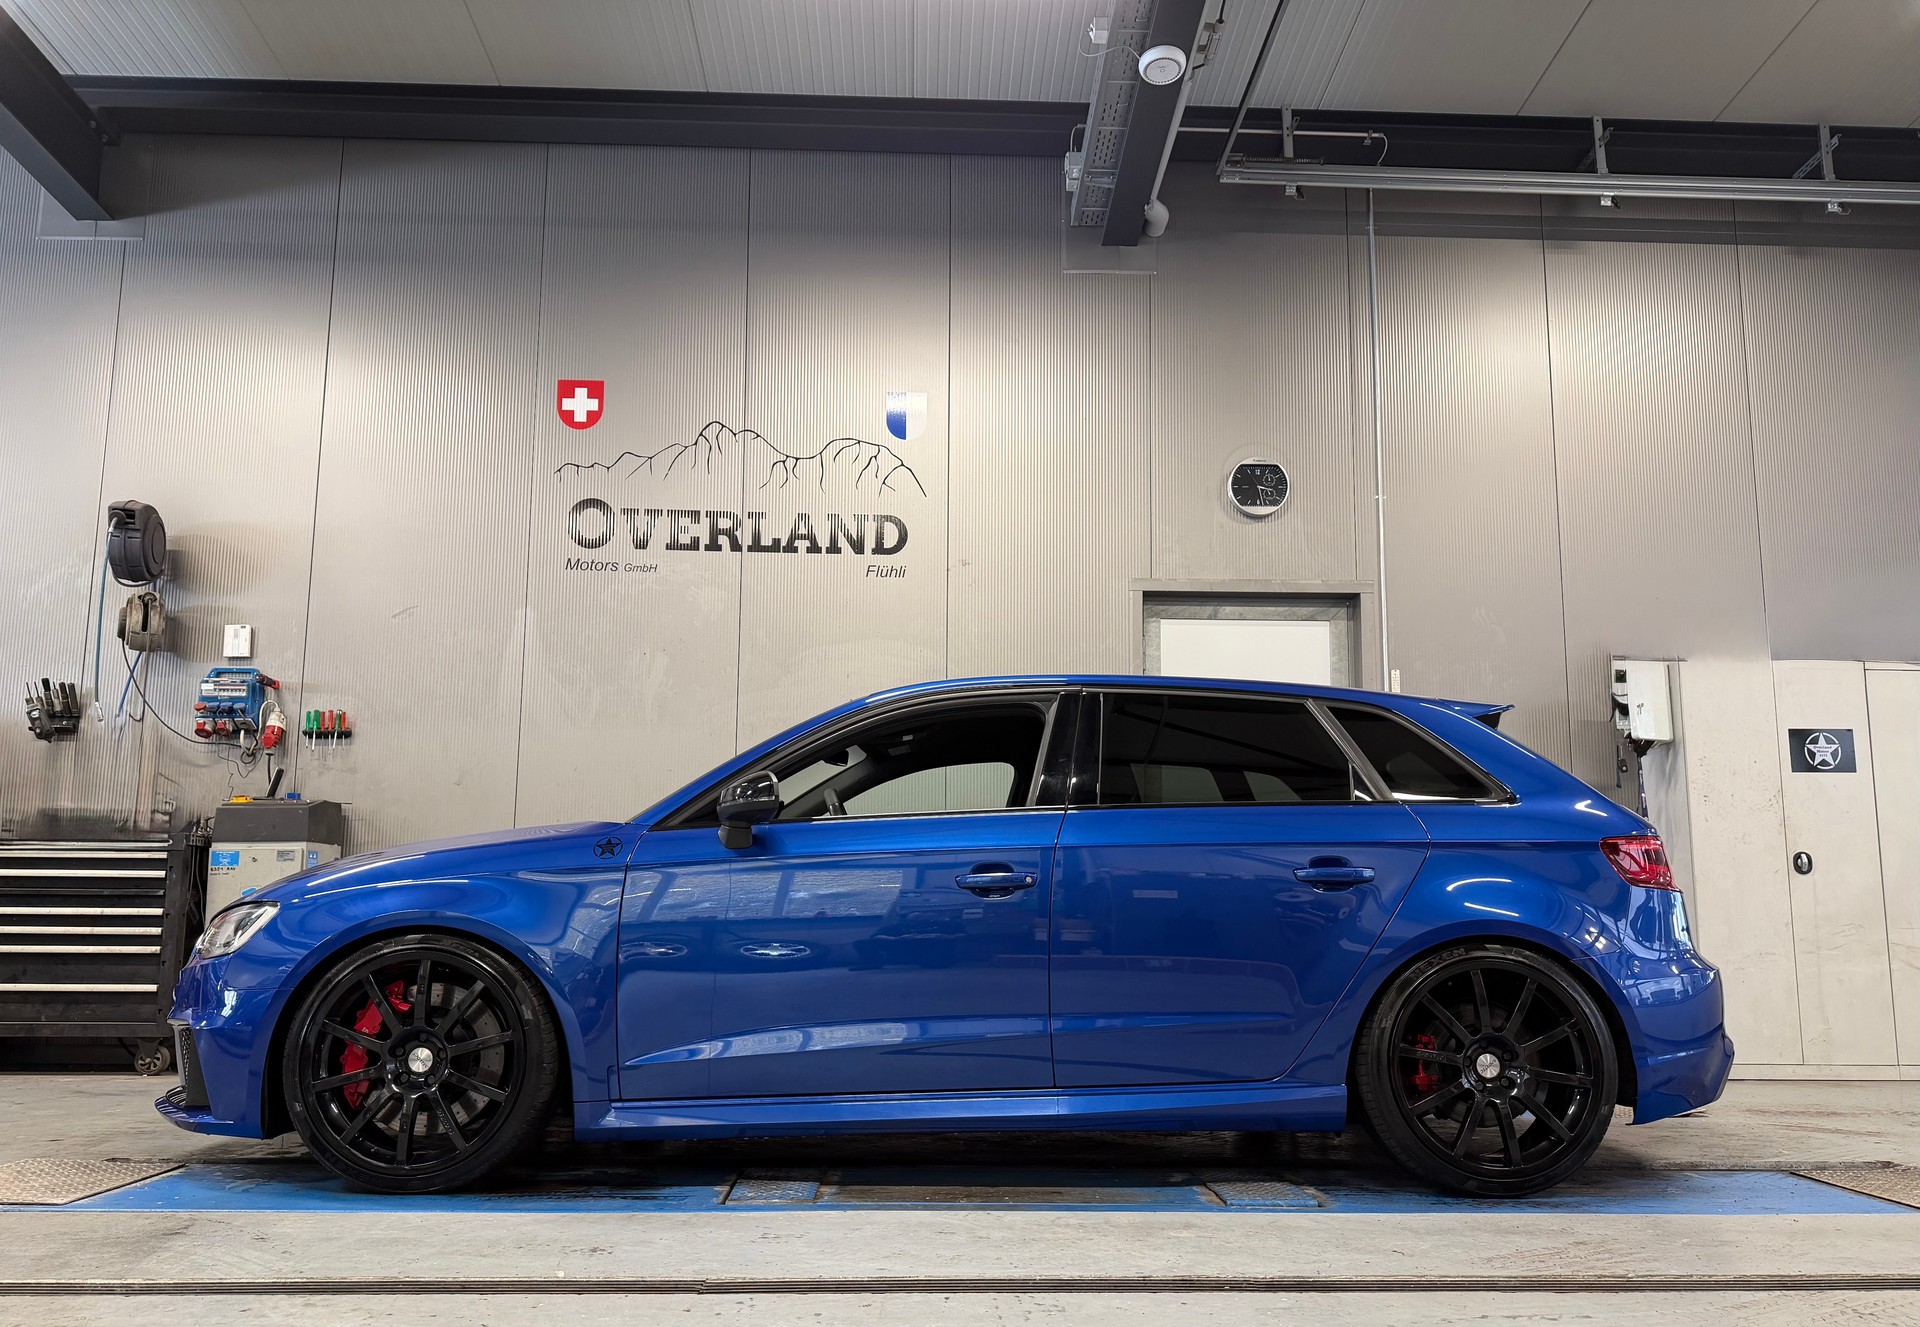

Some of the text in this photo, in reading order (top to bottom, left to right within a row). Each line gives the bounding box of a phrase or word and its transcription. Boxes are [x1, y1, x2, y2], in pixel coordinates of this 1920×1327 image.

[567, 497, 909, 556] OVERLAND
[565, 557, 658, 573] Motors GmbH
[866, 564, 907, 579] Flühli
[1409, 947, 1467, 981] NEXEN
